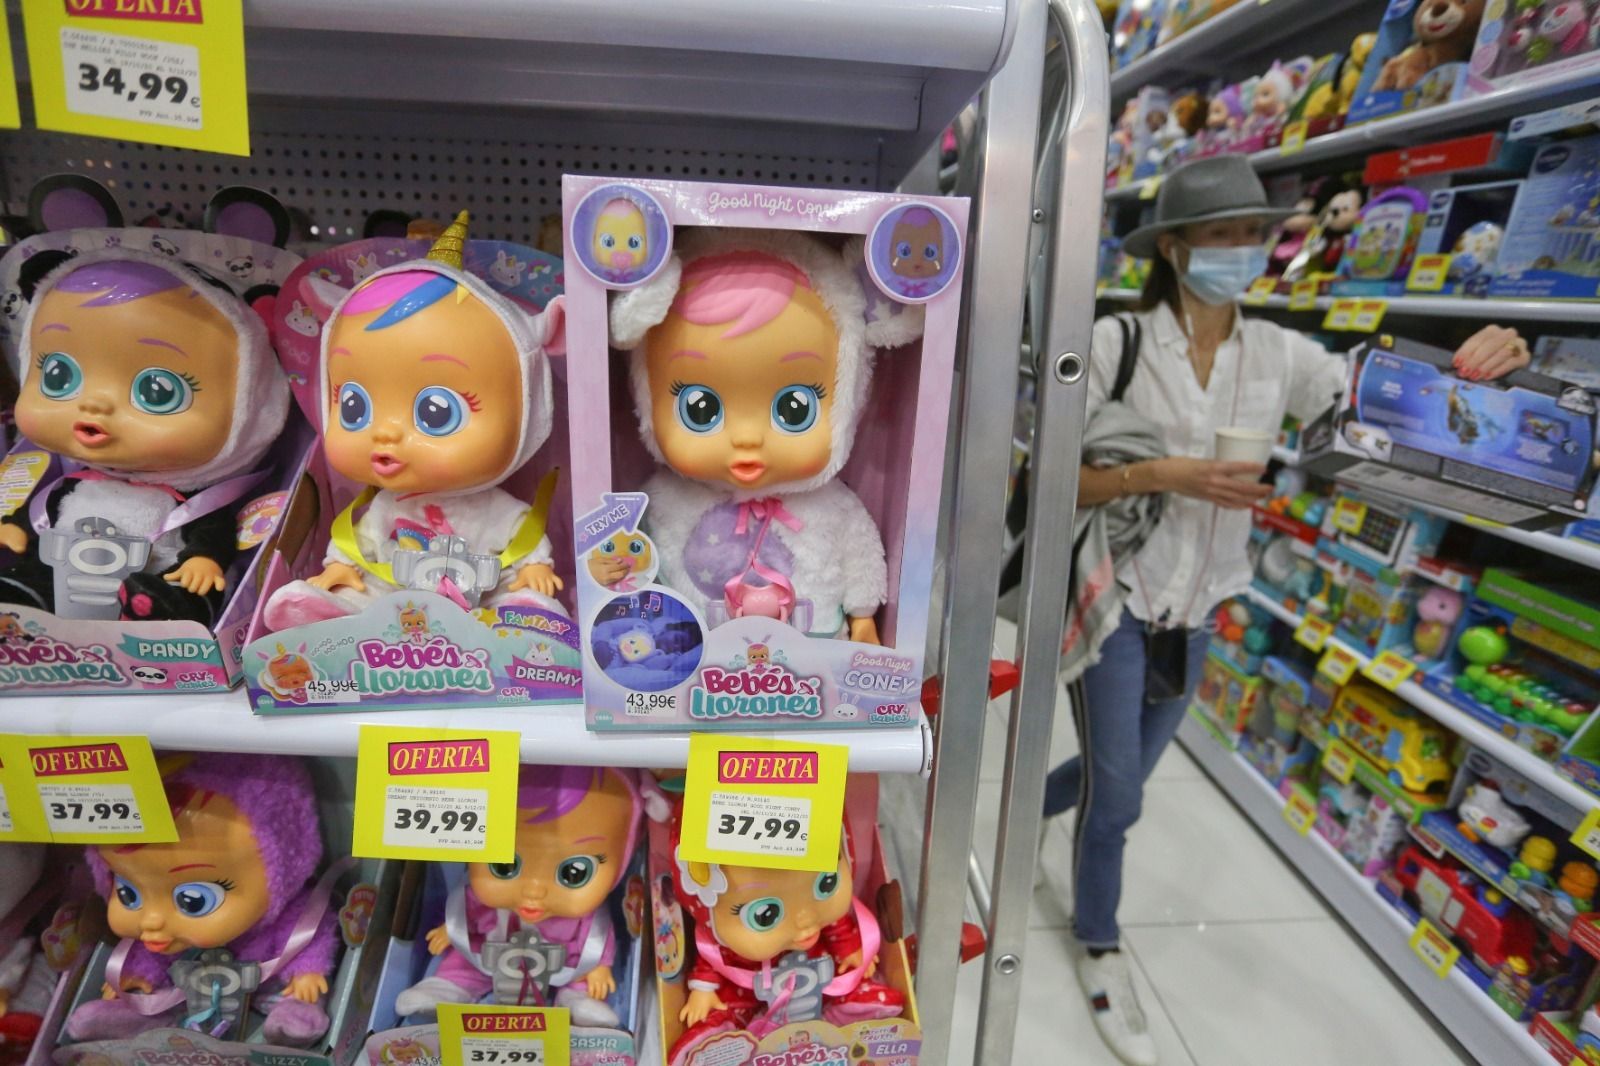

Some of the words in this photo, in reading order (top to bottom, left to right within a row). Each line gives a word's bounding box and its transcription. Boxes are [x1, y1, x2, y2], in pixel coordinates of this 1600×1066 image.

[78, 63, 201, 108] 34,99€
[708, 191, 752, 213] Good
[753, 192, 793, 216] Night
[586, 515, 608, 535] TRY
[608, 504, 630, 522] ME
[505, 611, 570, 635] FANTASY
[138, 642, 216, 659] PANDY
[362, 639, 463, 670] Bebés
[0, 663, 124, 683] orones
[885, 656, 911, 673] Night
[178, 671, 207, 683] CRY
[515, 666, 582, 687] DREAMY
[703, 667, 797, 696] Bebés
[844, 670, 916, 694] CONEY
[876, 704, 905, 715] CRY
[32, 749, 123, 773] OFERTA
[393, 745, 485, 771] OFERTA
[722, 757, 814, 779] OFERTA
[50, 803, 141, 822] 37,99€
[394, 808, 486, 834] 39,99€
[718, 814, 808, 841] 37,99€
[466, 1016, 543, 1031] OFERTA
[570, 1038, 618, 1049] SASHA
[875, 1043, 908, 1055] ELLA
[263, 1055, 309, 1066] LIZZY
